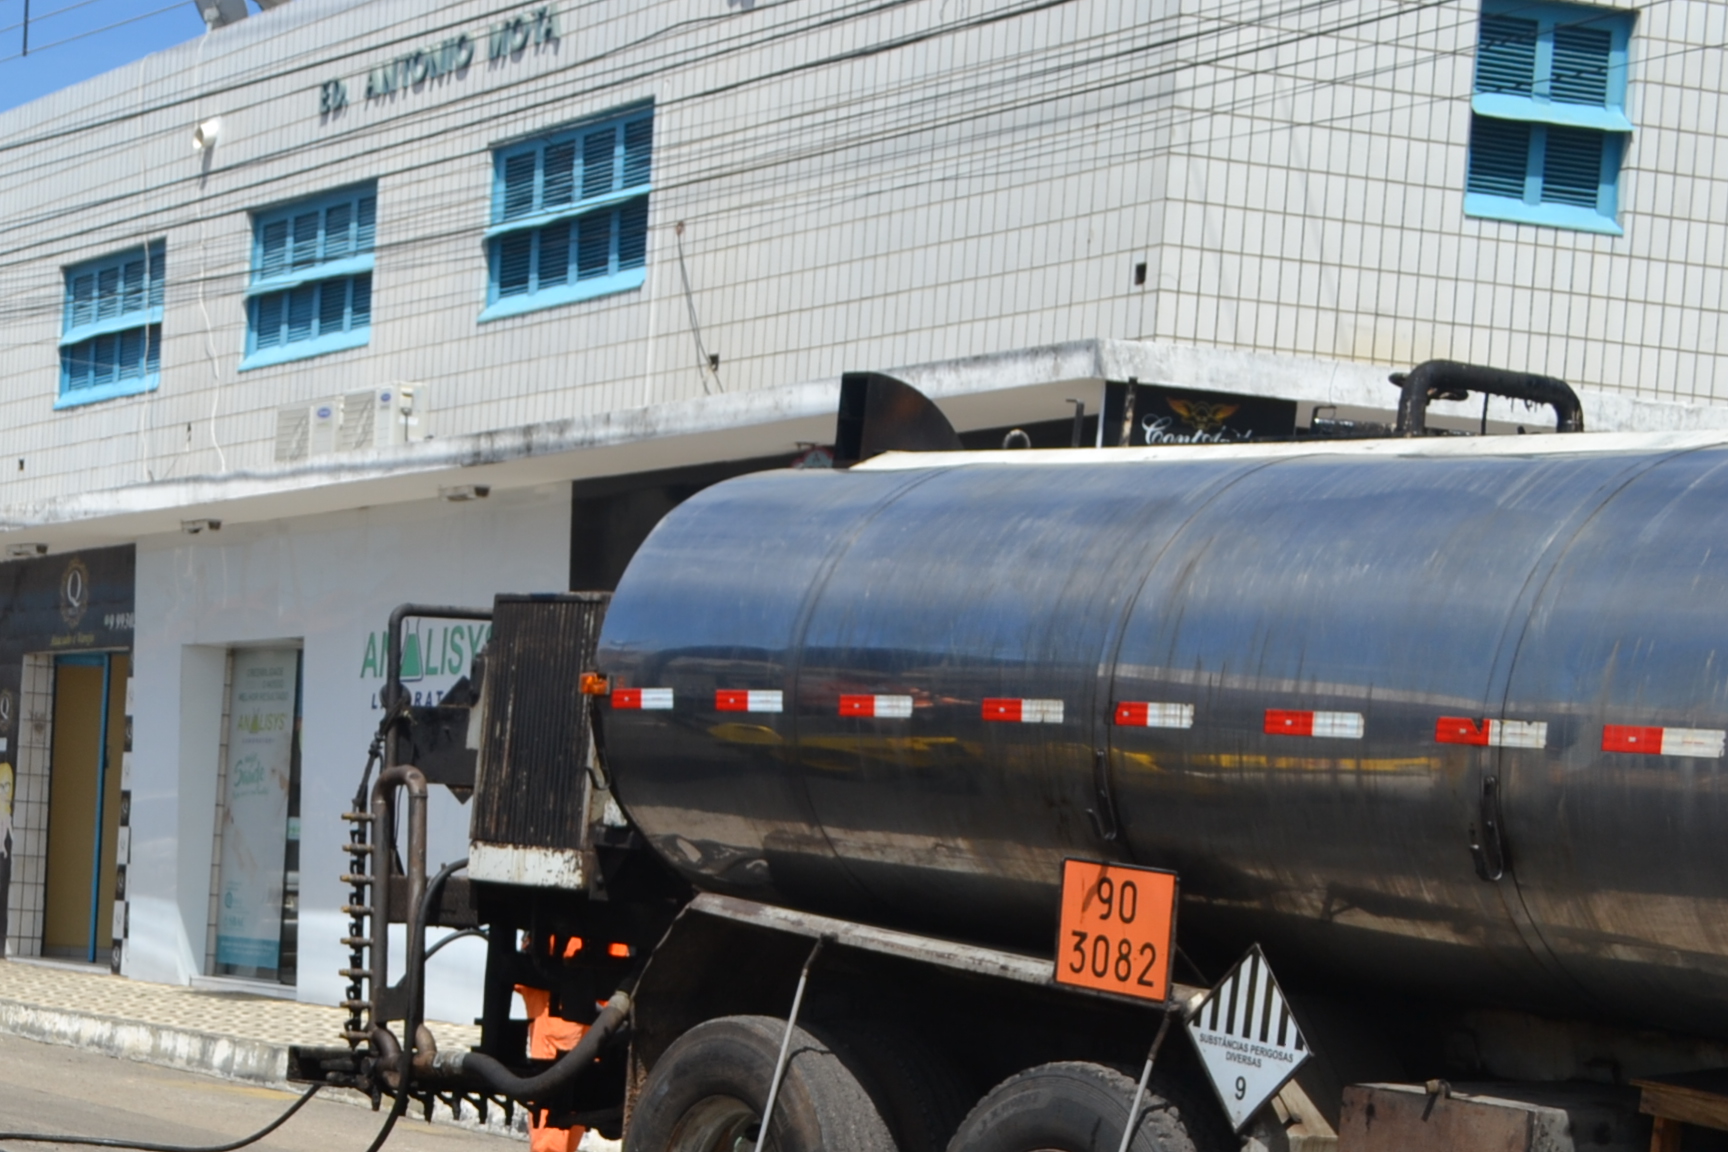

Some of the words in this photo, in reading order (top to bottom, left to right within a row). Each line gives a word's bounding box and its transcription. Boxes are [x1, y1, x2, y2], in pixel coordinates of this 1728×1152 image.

[364, 32, 475, 99] ANTONIO
[67, 570, 81, 607] Q
[1097, 876, 1138, 924] 90
[1069, 929, 1157, 987] 3082
[1199, 1032, 1248, 1054] SUBSTÂNCIAS
[1250, 1043, 1294, 1064] PERIGOSAS
[1225, 1051, 1262, 1069] DIVERSAS
[1234, 1075, 1247, 1101] 9
